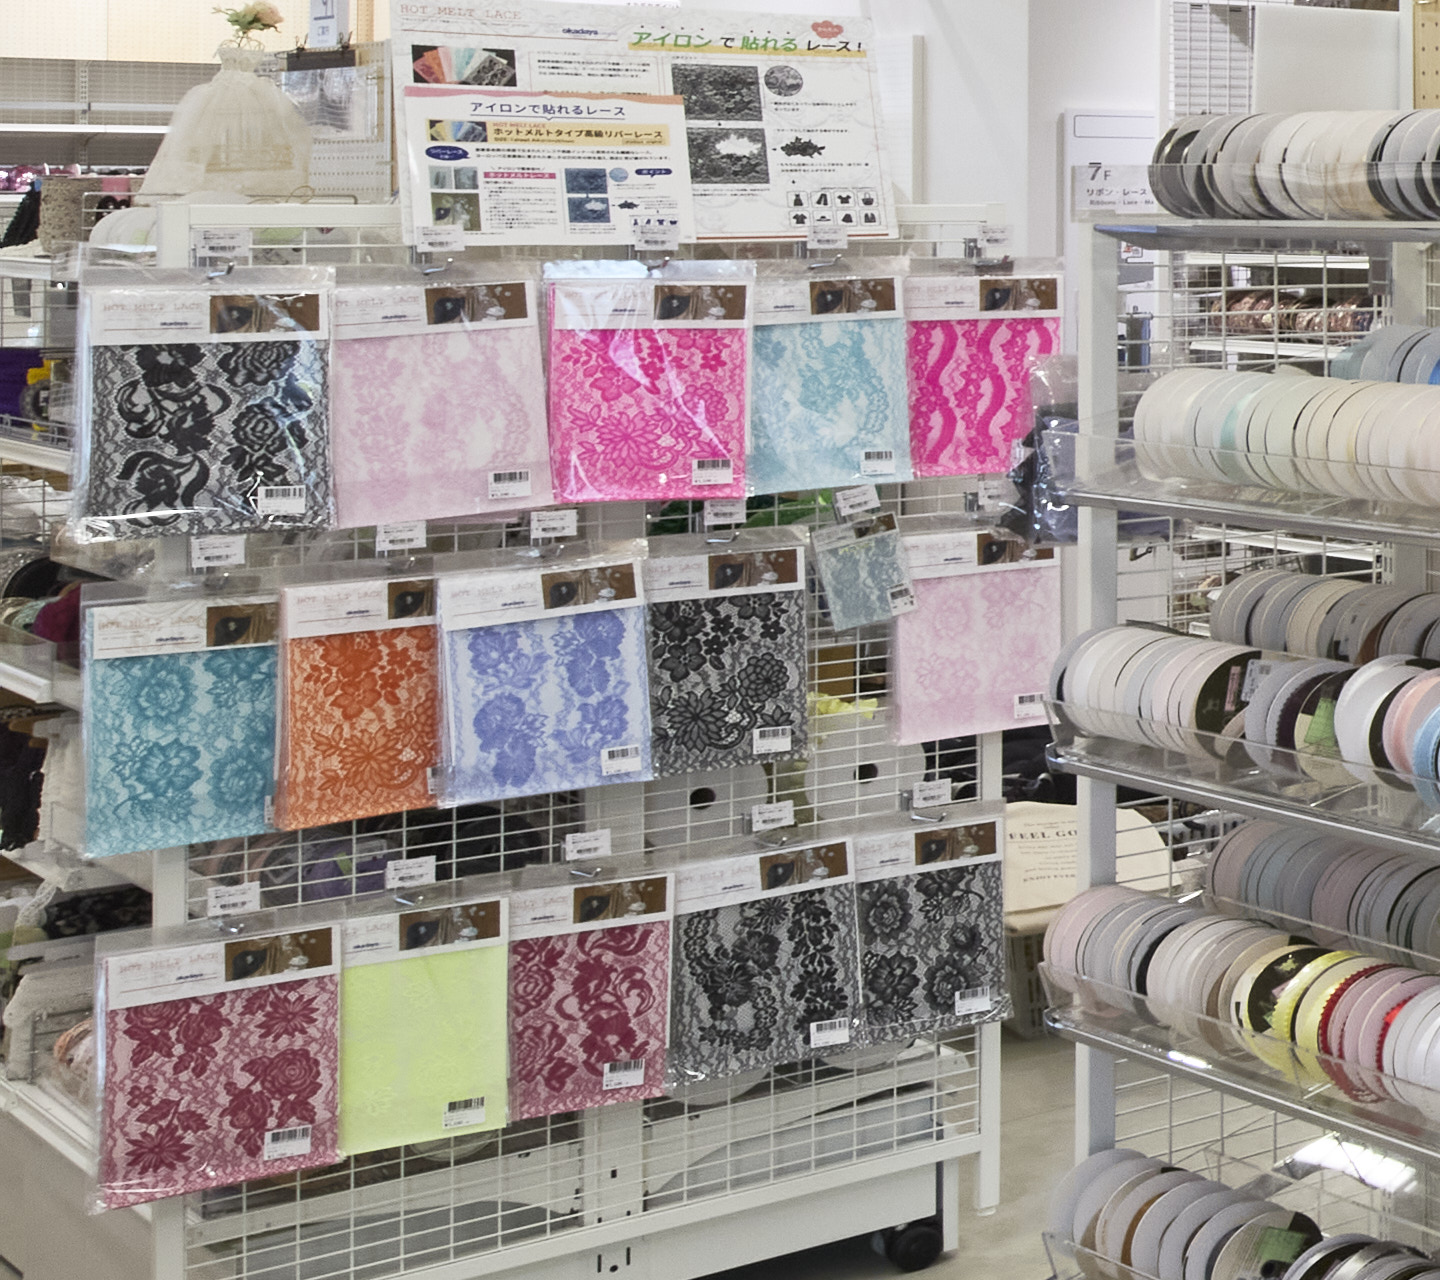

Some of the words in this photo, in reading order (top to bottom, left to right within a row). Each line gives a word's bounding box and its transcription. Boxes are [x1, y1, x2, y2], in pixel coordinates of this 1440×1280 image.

[470, 101, 627, 117] アイロンで貼れるレース
